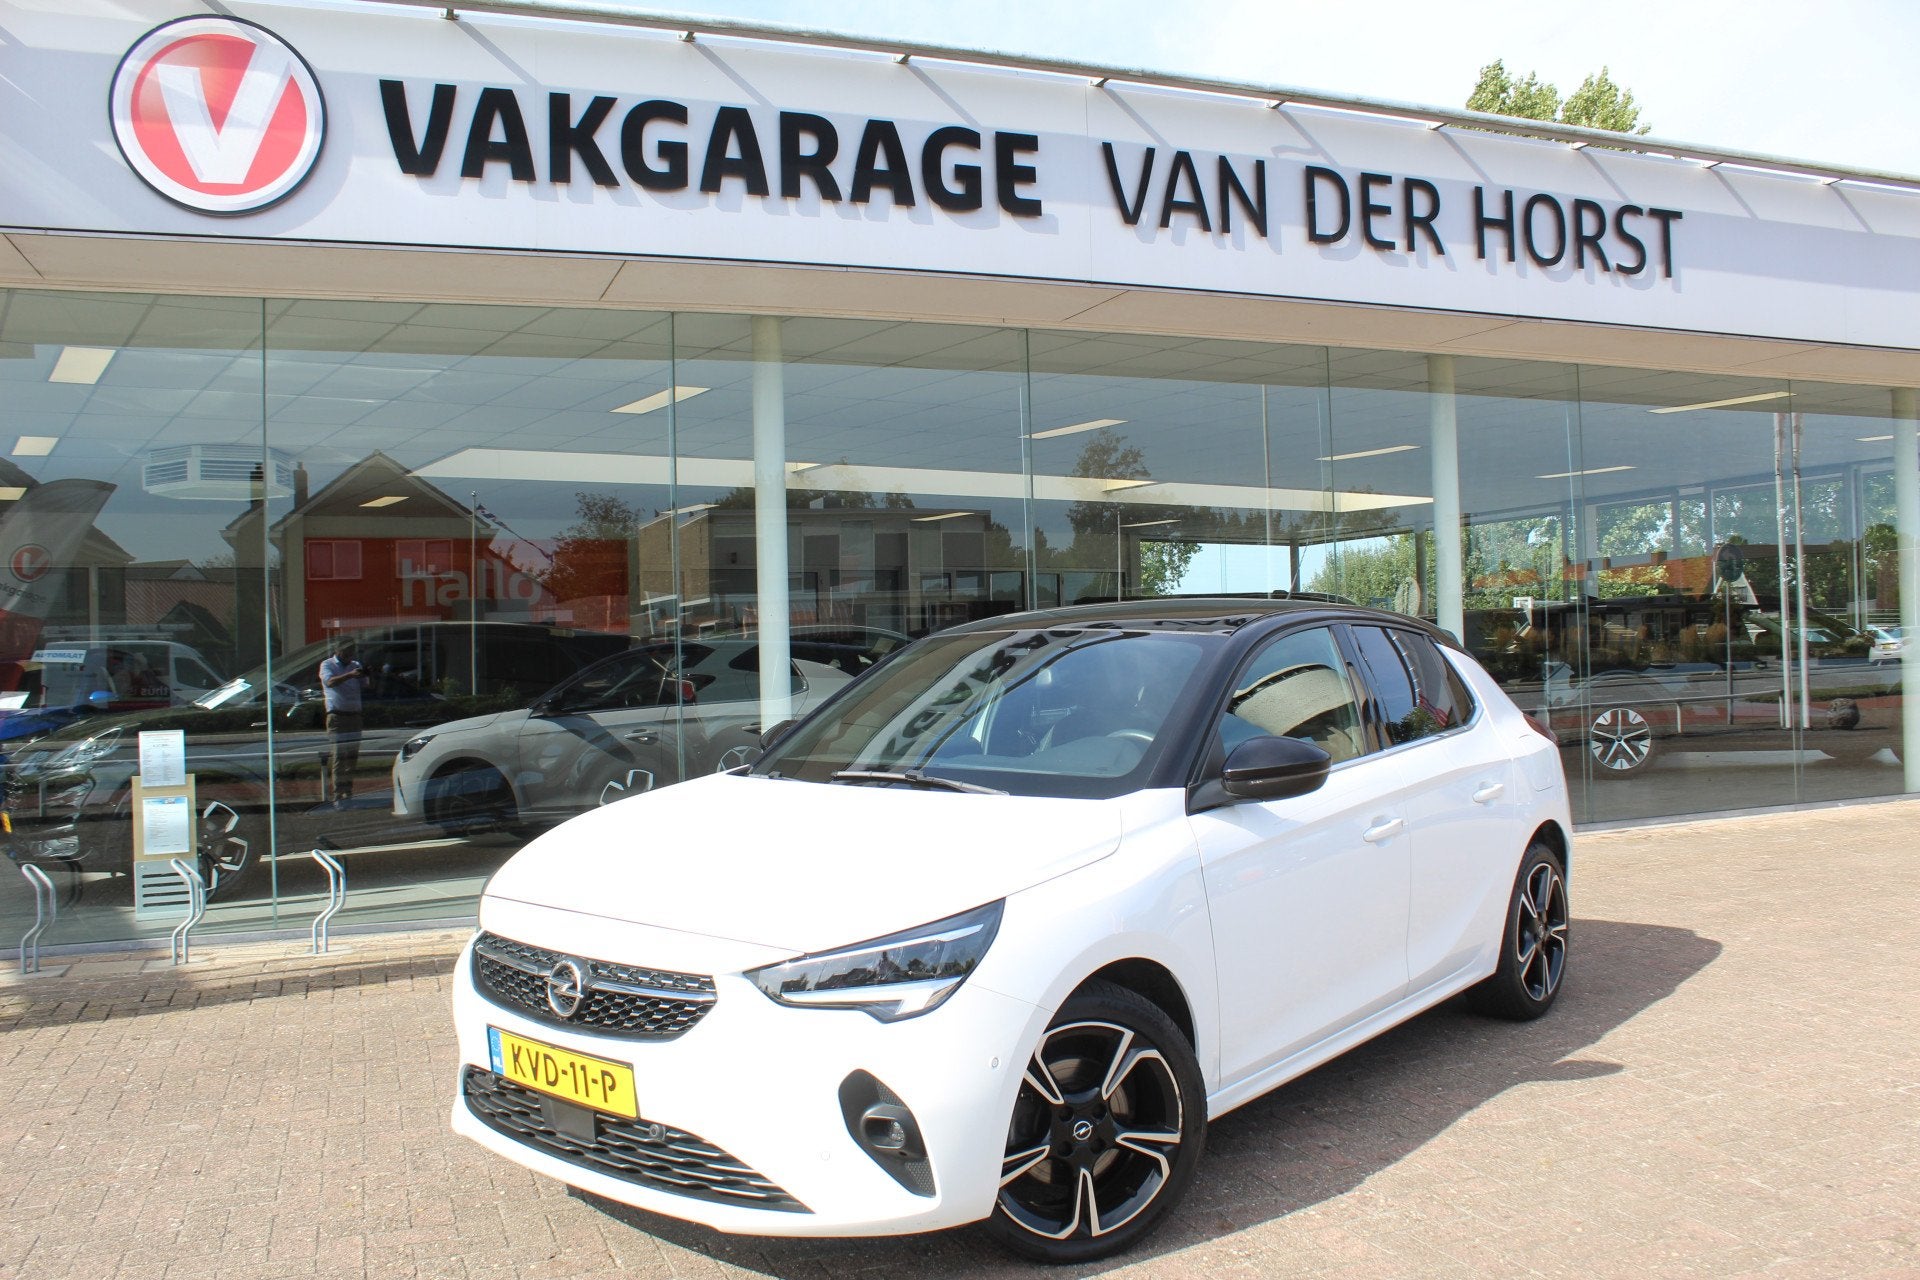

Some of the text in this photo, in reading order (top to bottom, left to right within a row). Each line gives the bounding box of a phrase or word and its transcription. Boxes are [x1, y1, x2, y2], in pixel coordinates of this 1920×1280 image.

[378, 79, 1683, 278] VAKGARAGE VAN DER HORST
[402, 558, 542, 608] hallo
[511, 1043, 617, 1103] KVD-11-P
